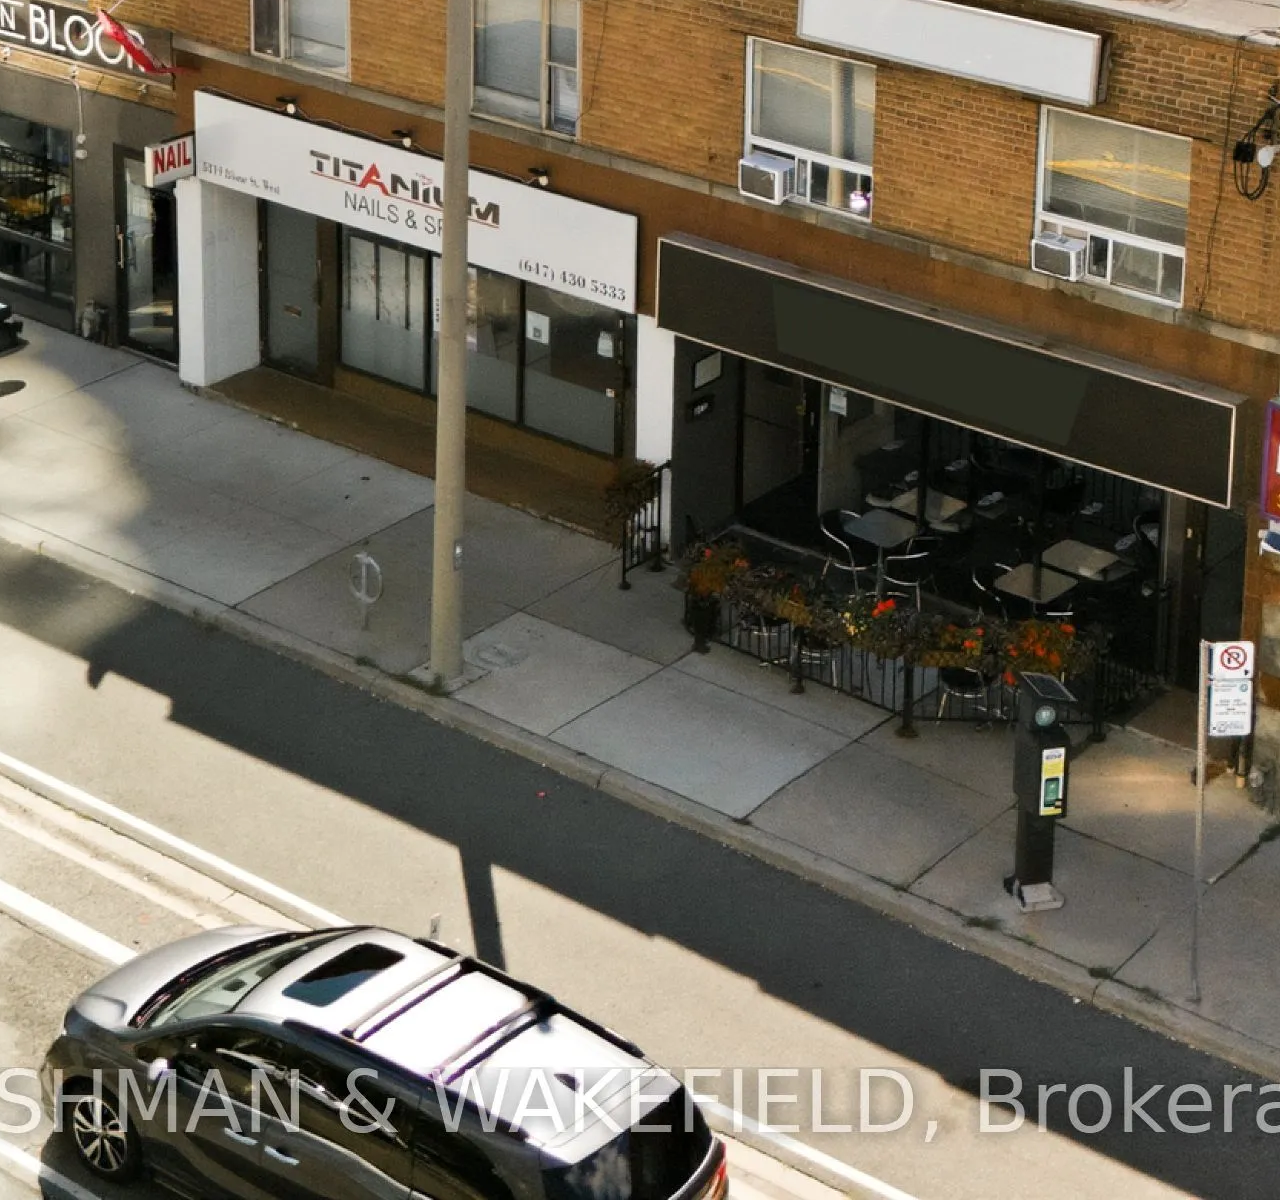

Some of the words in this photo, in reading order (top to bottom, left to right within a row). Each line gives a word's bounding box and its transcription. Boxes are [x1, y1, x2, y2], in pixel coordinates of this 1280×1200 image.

[153, 140, 192, 175] NAIL
[344, 190, 400, 225] NAILS
[404, 209, 418, 230] &
[519, 259, 555, 281] (647)
[560, 270, 586, 289] 430
